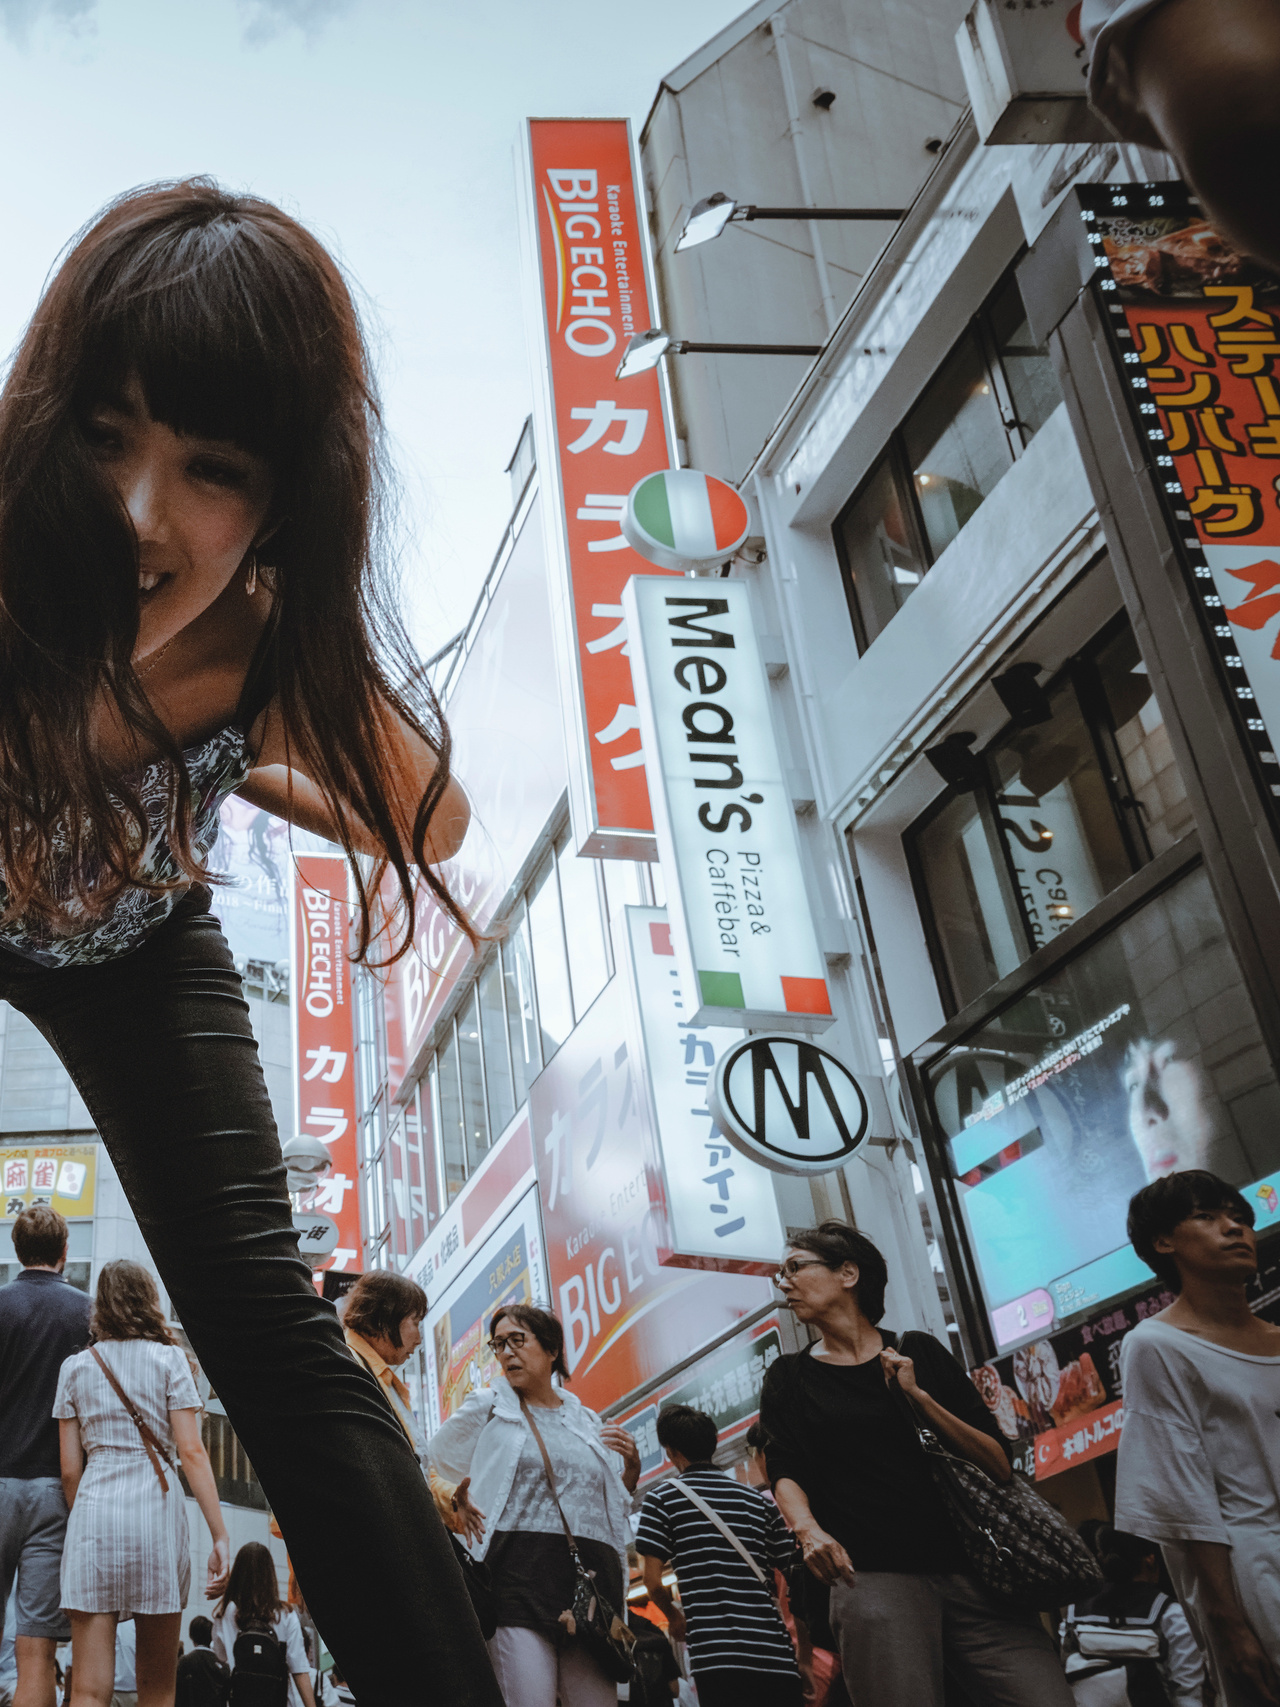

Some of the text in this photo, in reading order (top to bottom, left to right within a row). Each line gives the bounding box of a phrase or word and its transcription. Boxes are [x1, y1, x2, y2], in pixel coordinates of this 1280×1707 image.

[546, 168, 617, 357] BIG ECHO
[606, 184, 637, 338] Karaoke Entertainment
[1139, 325, 1255, 534] ハンバーグ
[664, 596, 766, 834] Mean's
[302, 888, 334, 1018] BIG ECHO
[6, 1161, 55, 1189] 麻雀
[544, 1041, 639, 1213] カラ
[558, 1247, 623, 1377] BIG
